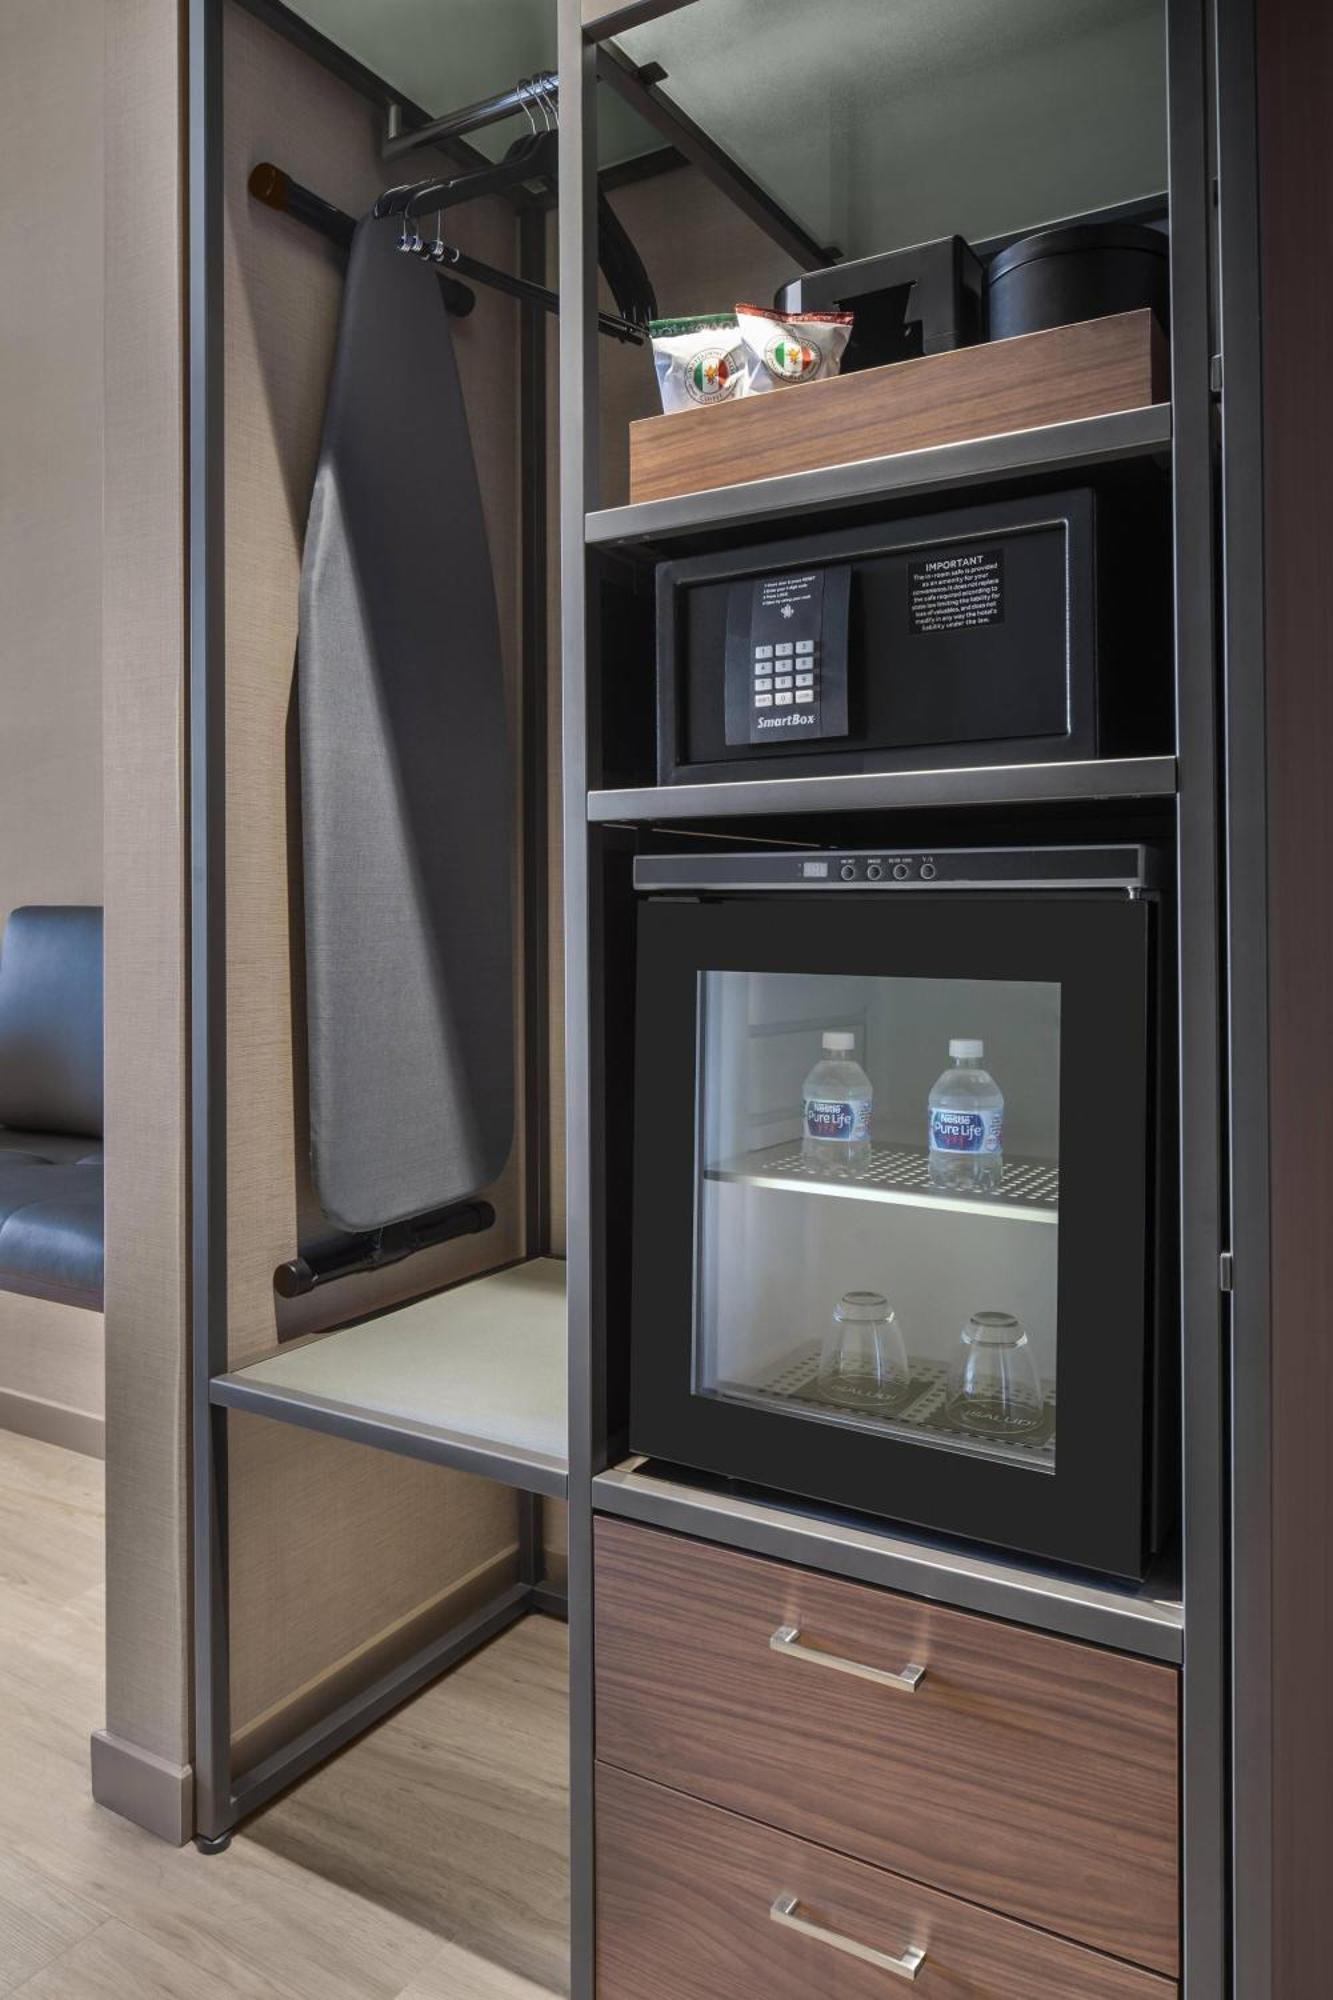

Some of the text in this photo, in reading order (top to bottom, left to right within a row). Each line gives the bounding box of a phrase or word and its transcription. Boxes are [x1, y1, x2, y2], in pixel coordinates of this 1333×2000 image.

[926, 555, 984, 572] IMPORTANT
[757, 713, 815, 729] SmartBox
[807, 1110, 831, 1124] Pure
[831, 1112, 852, 1129] Life
[934, 1120, 960, 1136] Pure
[960, 1124, 983, 1142] Life
